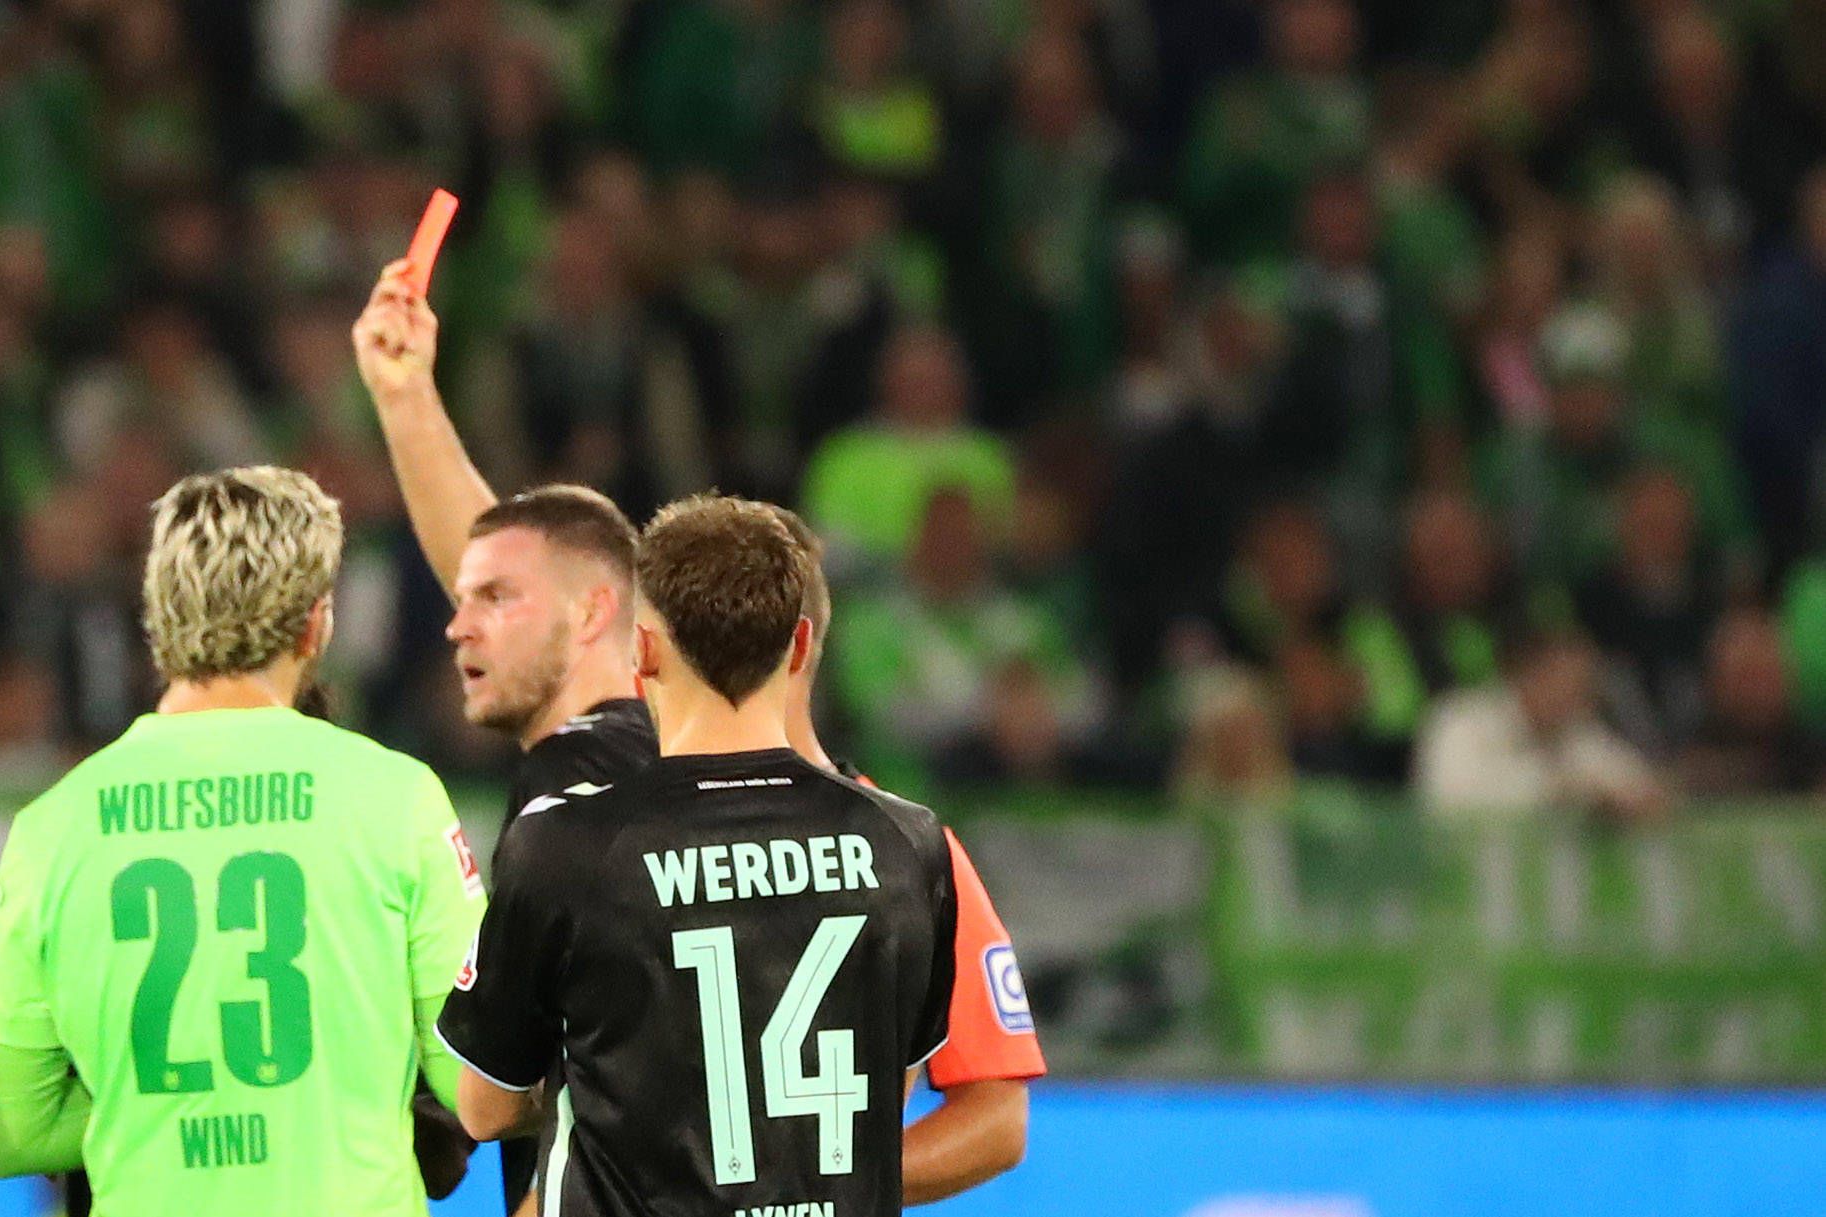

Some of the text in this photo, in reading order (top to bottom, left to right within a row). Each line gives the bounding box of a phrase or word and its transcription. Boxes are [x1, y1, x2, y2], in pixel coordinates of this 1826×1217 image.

[98, 771, 315, 835] WOLFSBURG
[643, 834, 879, 907] WERDER
[110, 849, 313, 1096] 23
[671, 914, 869, 1185] 14
[179, 1112, 269, 1169] WIND
